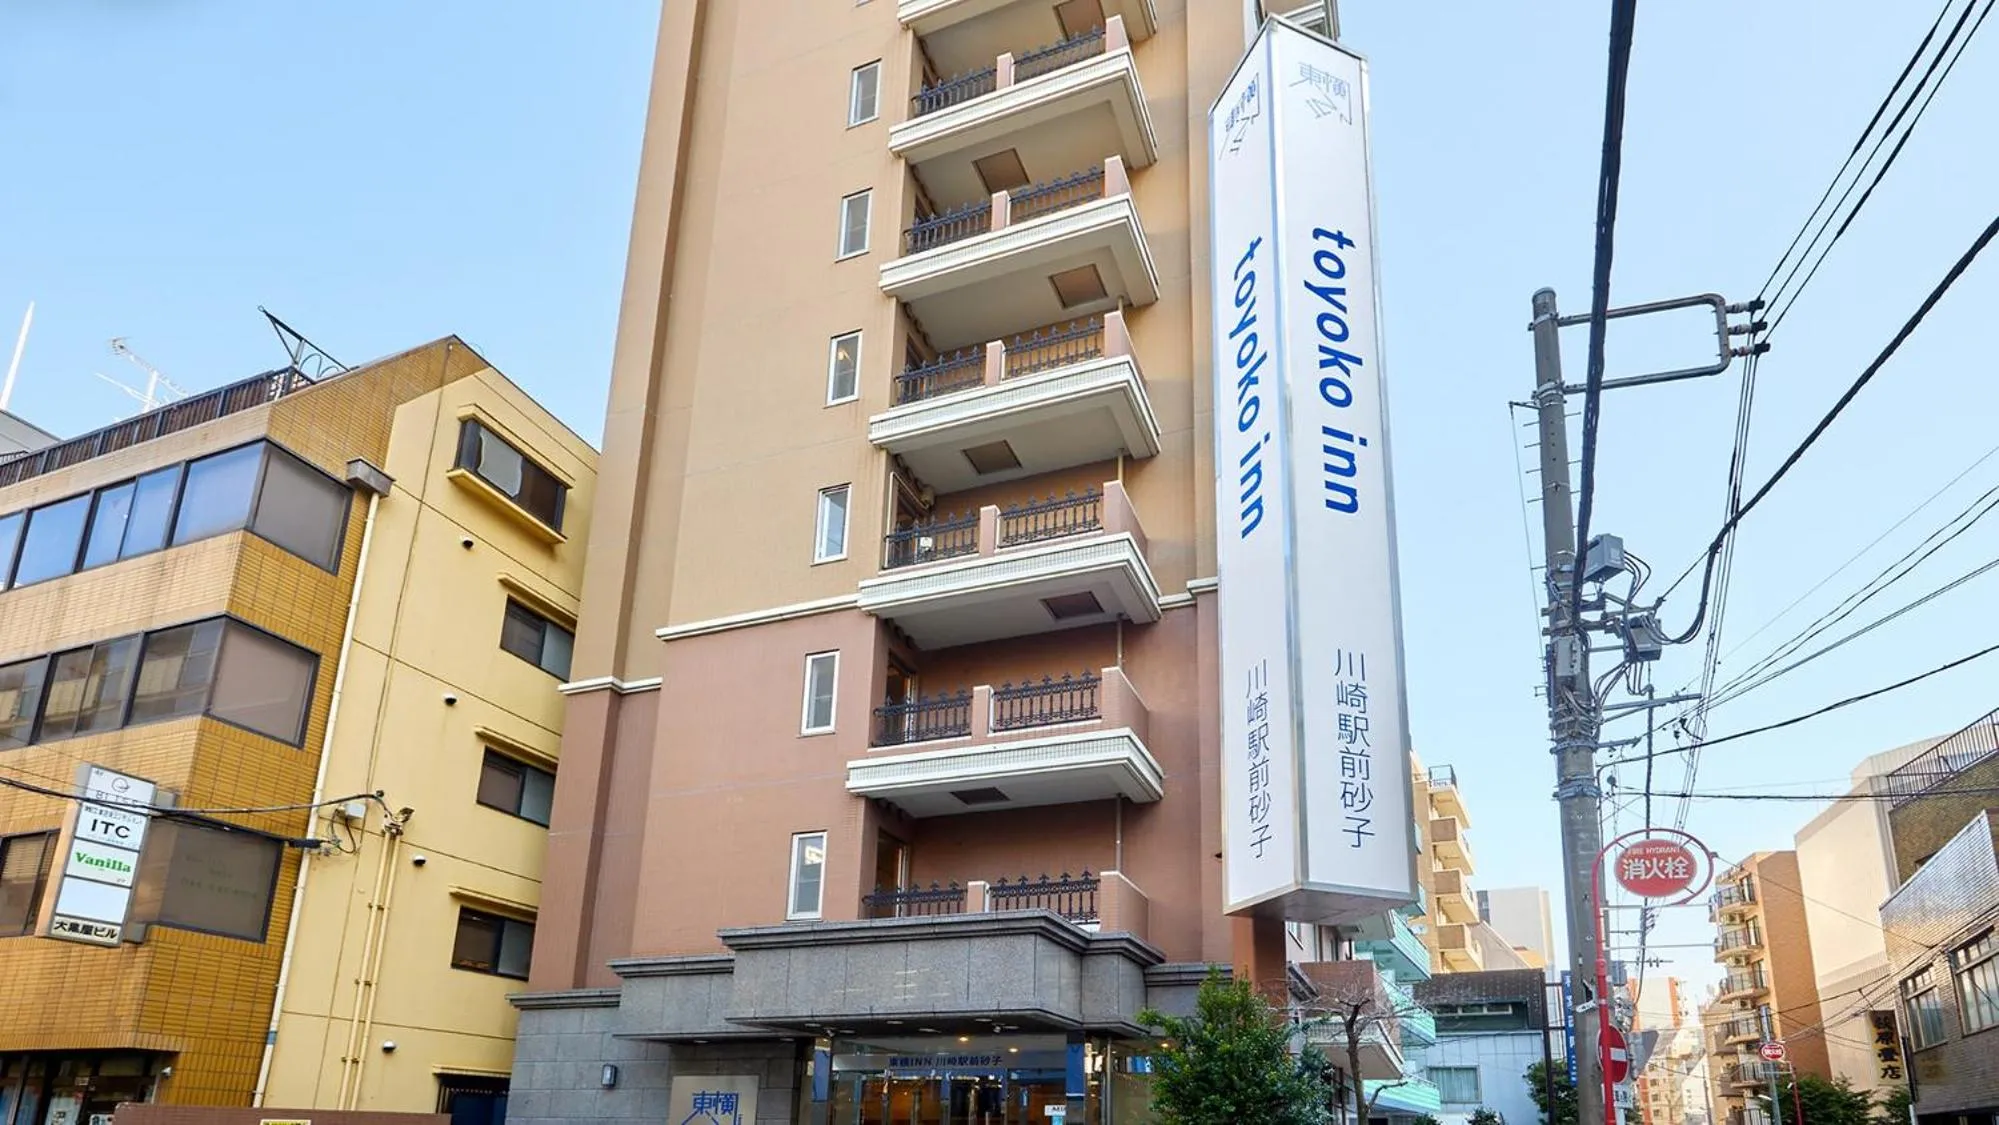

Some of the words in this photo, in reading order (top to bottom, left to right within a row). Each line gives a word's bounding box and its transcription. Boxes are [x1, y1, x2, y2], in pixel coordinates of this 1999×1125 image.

[1229, 236, 1268, 432] toyoko
[1304, 227, 1363, 408] toyoko
[1240, 432, 1271, 539] inn
[1322, 425, 1368, 514] inn
[1246, 659, 1272, 859] 川崎駅前砂子
[1335, 648, 1375, 848] 川崎駅前砂子
[76, 852, 131, 873] Vanilla
[91, 819, 130, 838] ITC
[1622, 856, 1690, 880] 消火栓
